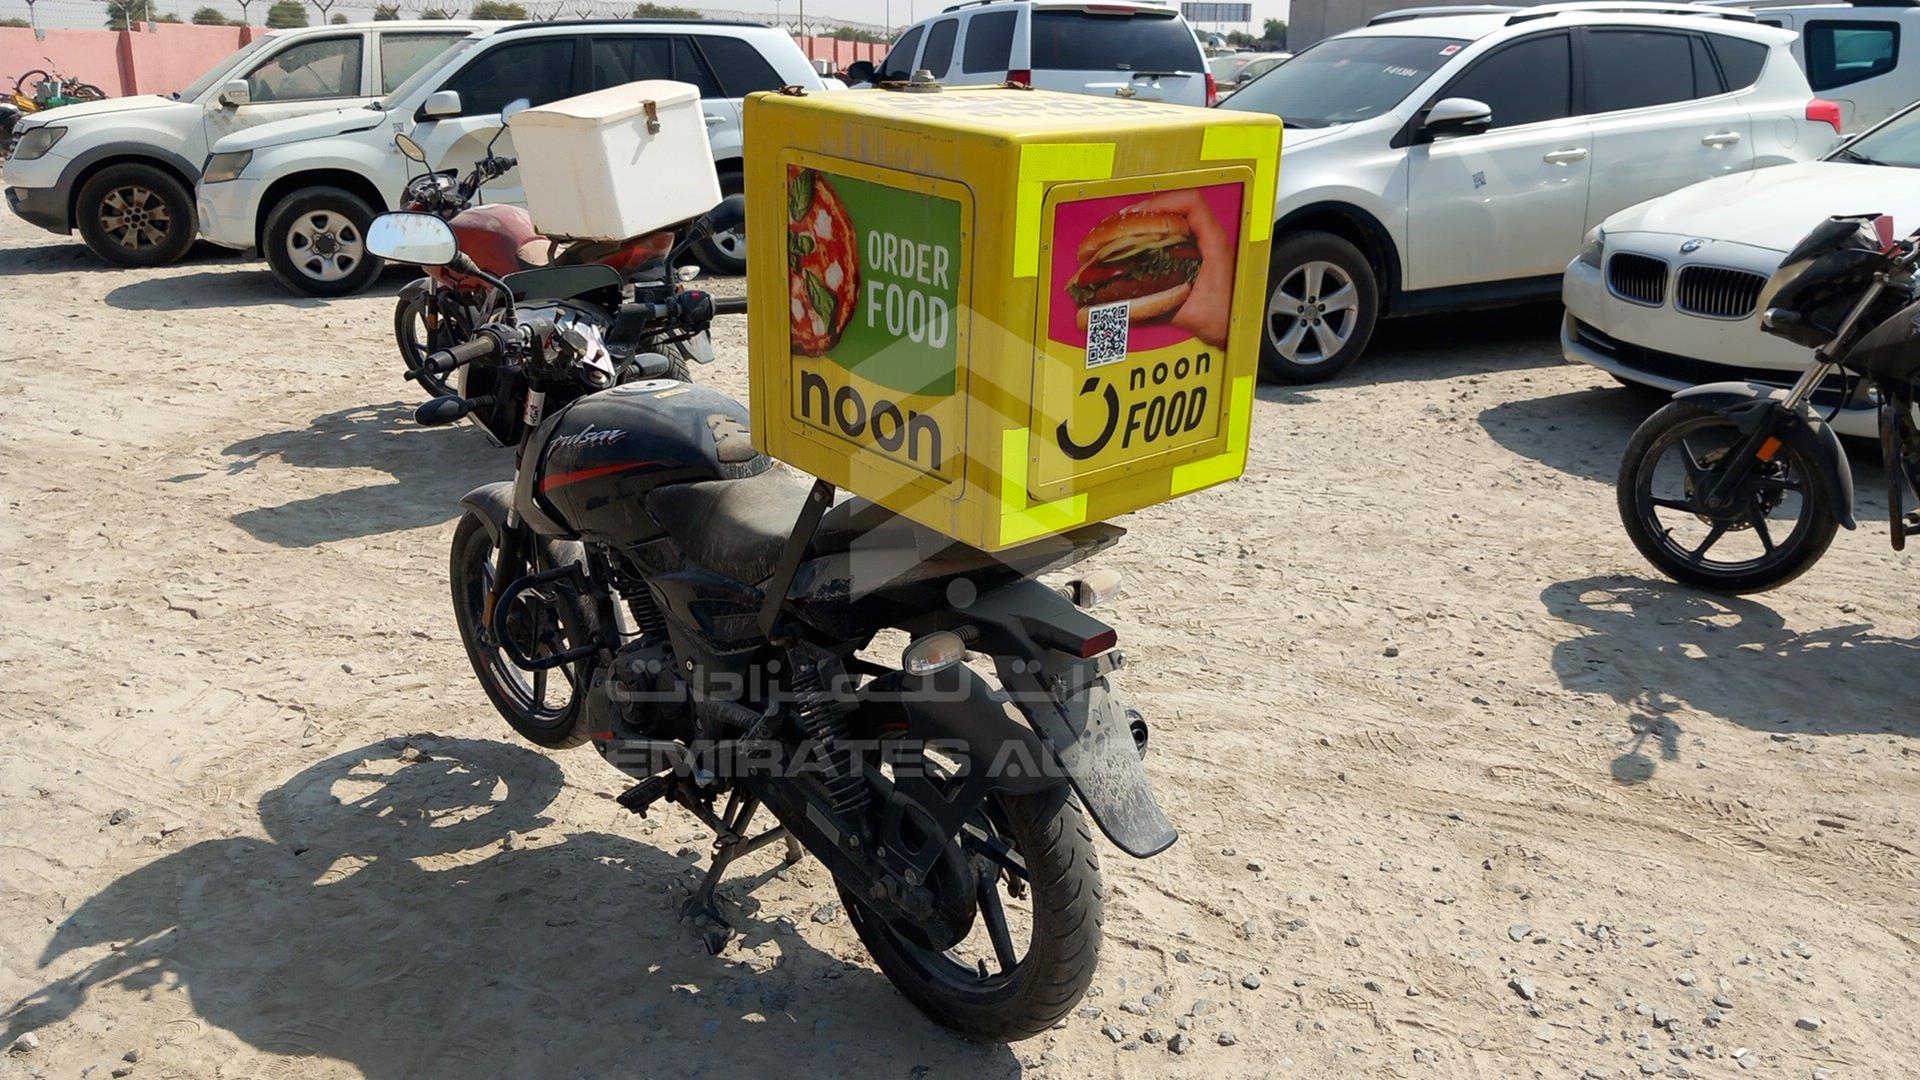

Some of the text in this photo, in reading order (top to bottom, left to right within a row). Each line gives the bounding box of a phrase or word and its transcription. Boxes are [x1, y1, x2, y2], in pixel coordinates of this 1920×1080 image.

[867, 230, 950, 290] ORDER
[867, 279, 950, 349] FOOD
[1129, 352, 1211, 391] noon
[801, 370, 942, 472] noon
[1121, 386, 1208, 449] FOOD
